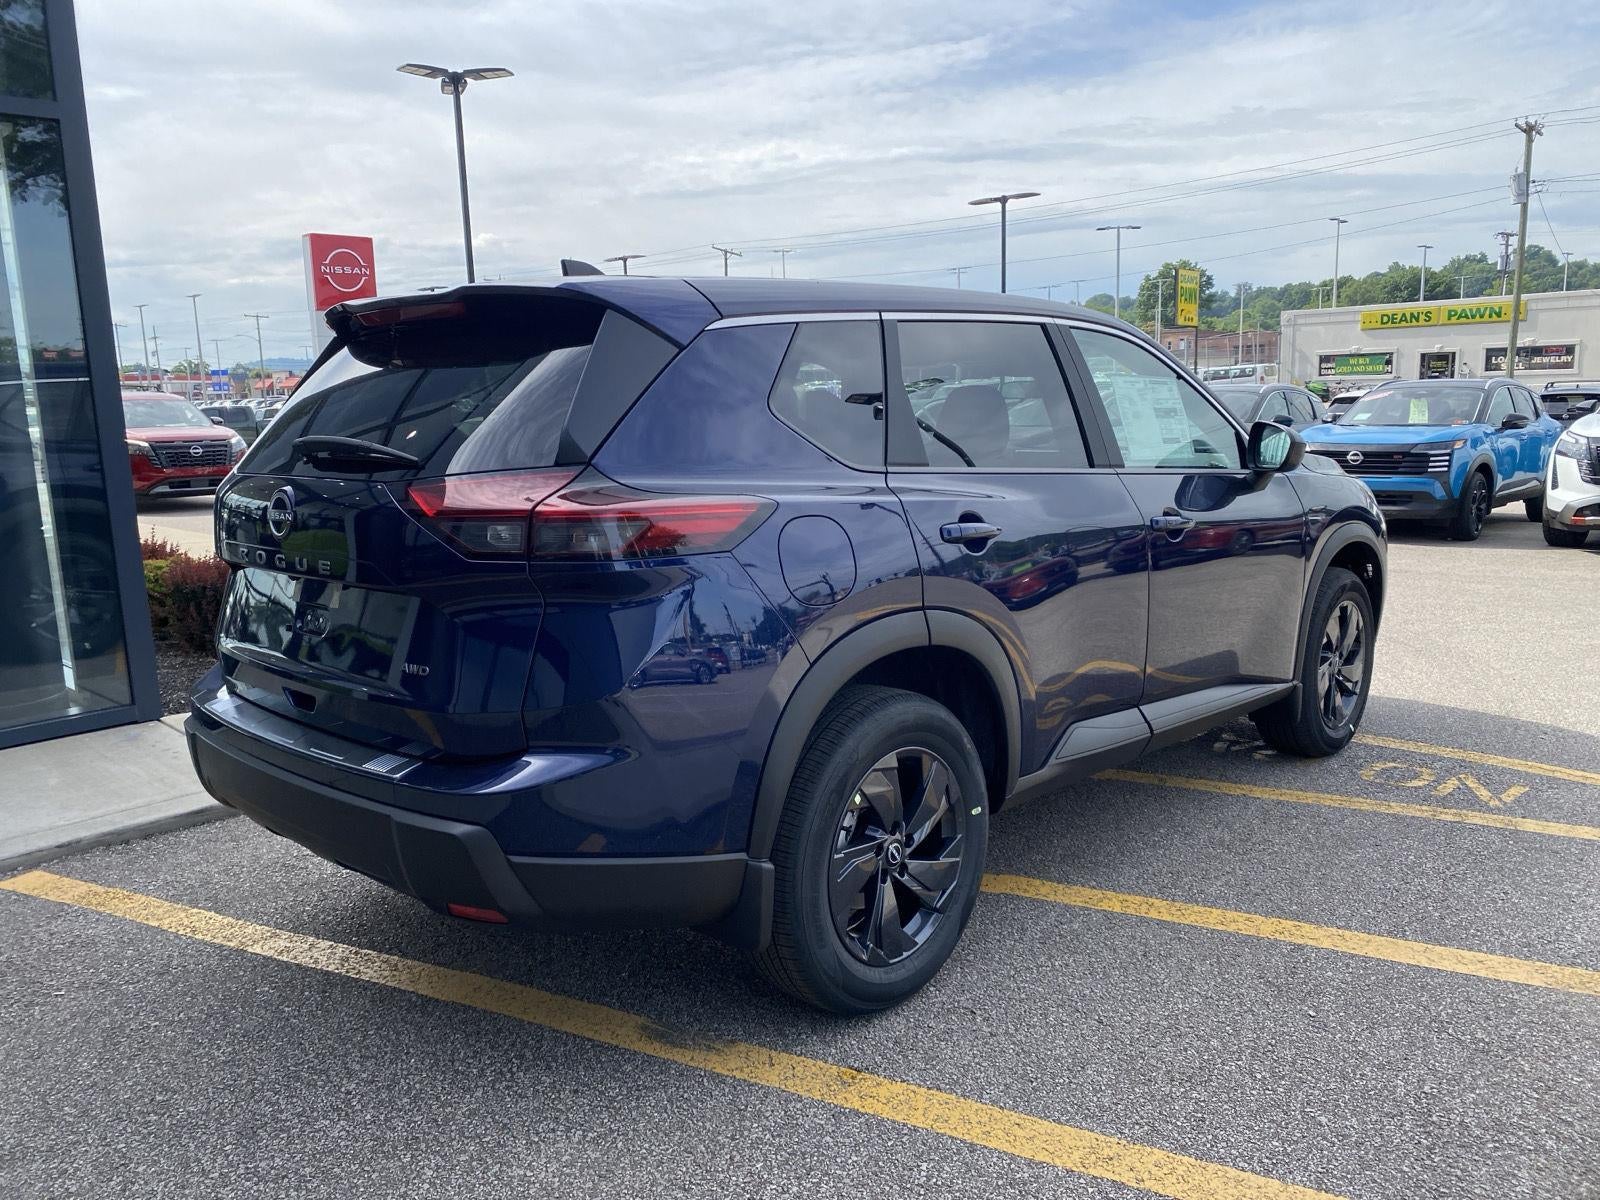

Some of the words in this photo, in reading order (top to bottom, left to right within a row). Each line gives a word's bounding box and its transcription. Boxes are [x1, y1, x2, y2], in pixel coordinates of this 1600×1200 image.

[321, 265, 369, 275] NISSAN
[1380, 310, 1433, 325] DEAN'S
[1447, 306, 1502, 321] PAWN
[1531, 355, 1574, 363] JEWELRY
[1366, 364, 1384, 372] SILVER
[1500, 362, 1525, 370] SLL
[239, 547, 331, 574] ROGUE
[401, 662, 430, 676] AWD
